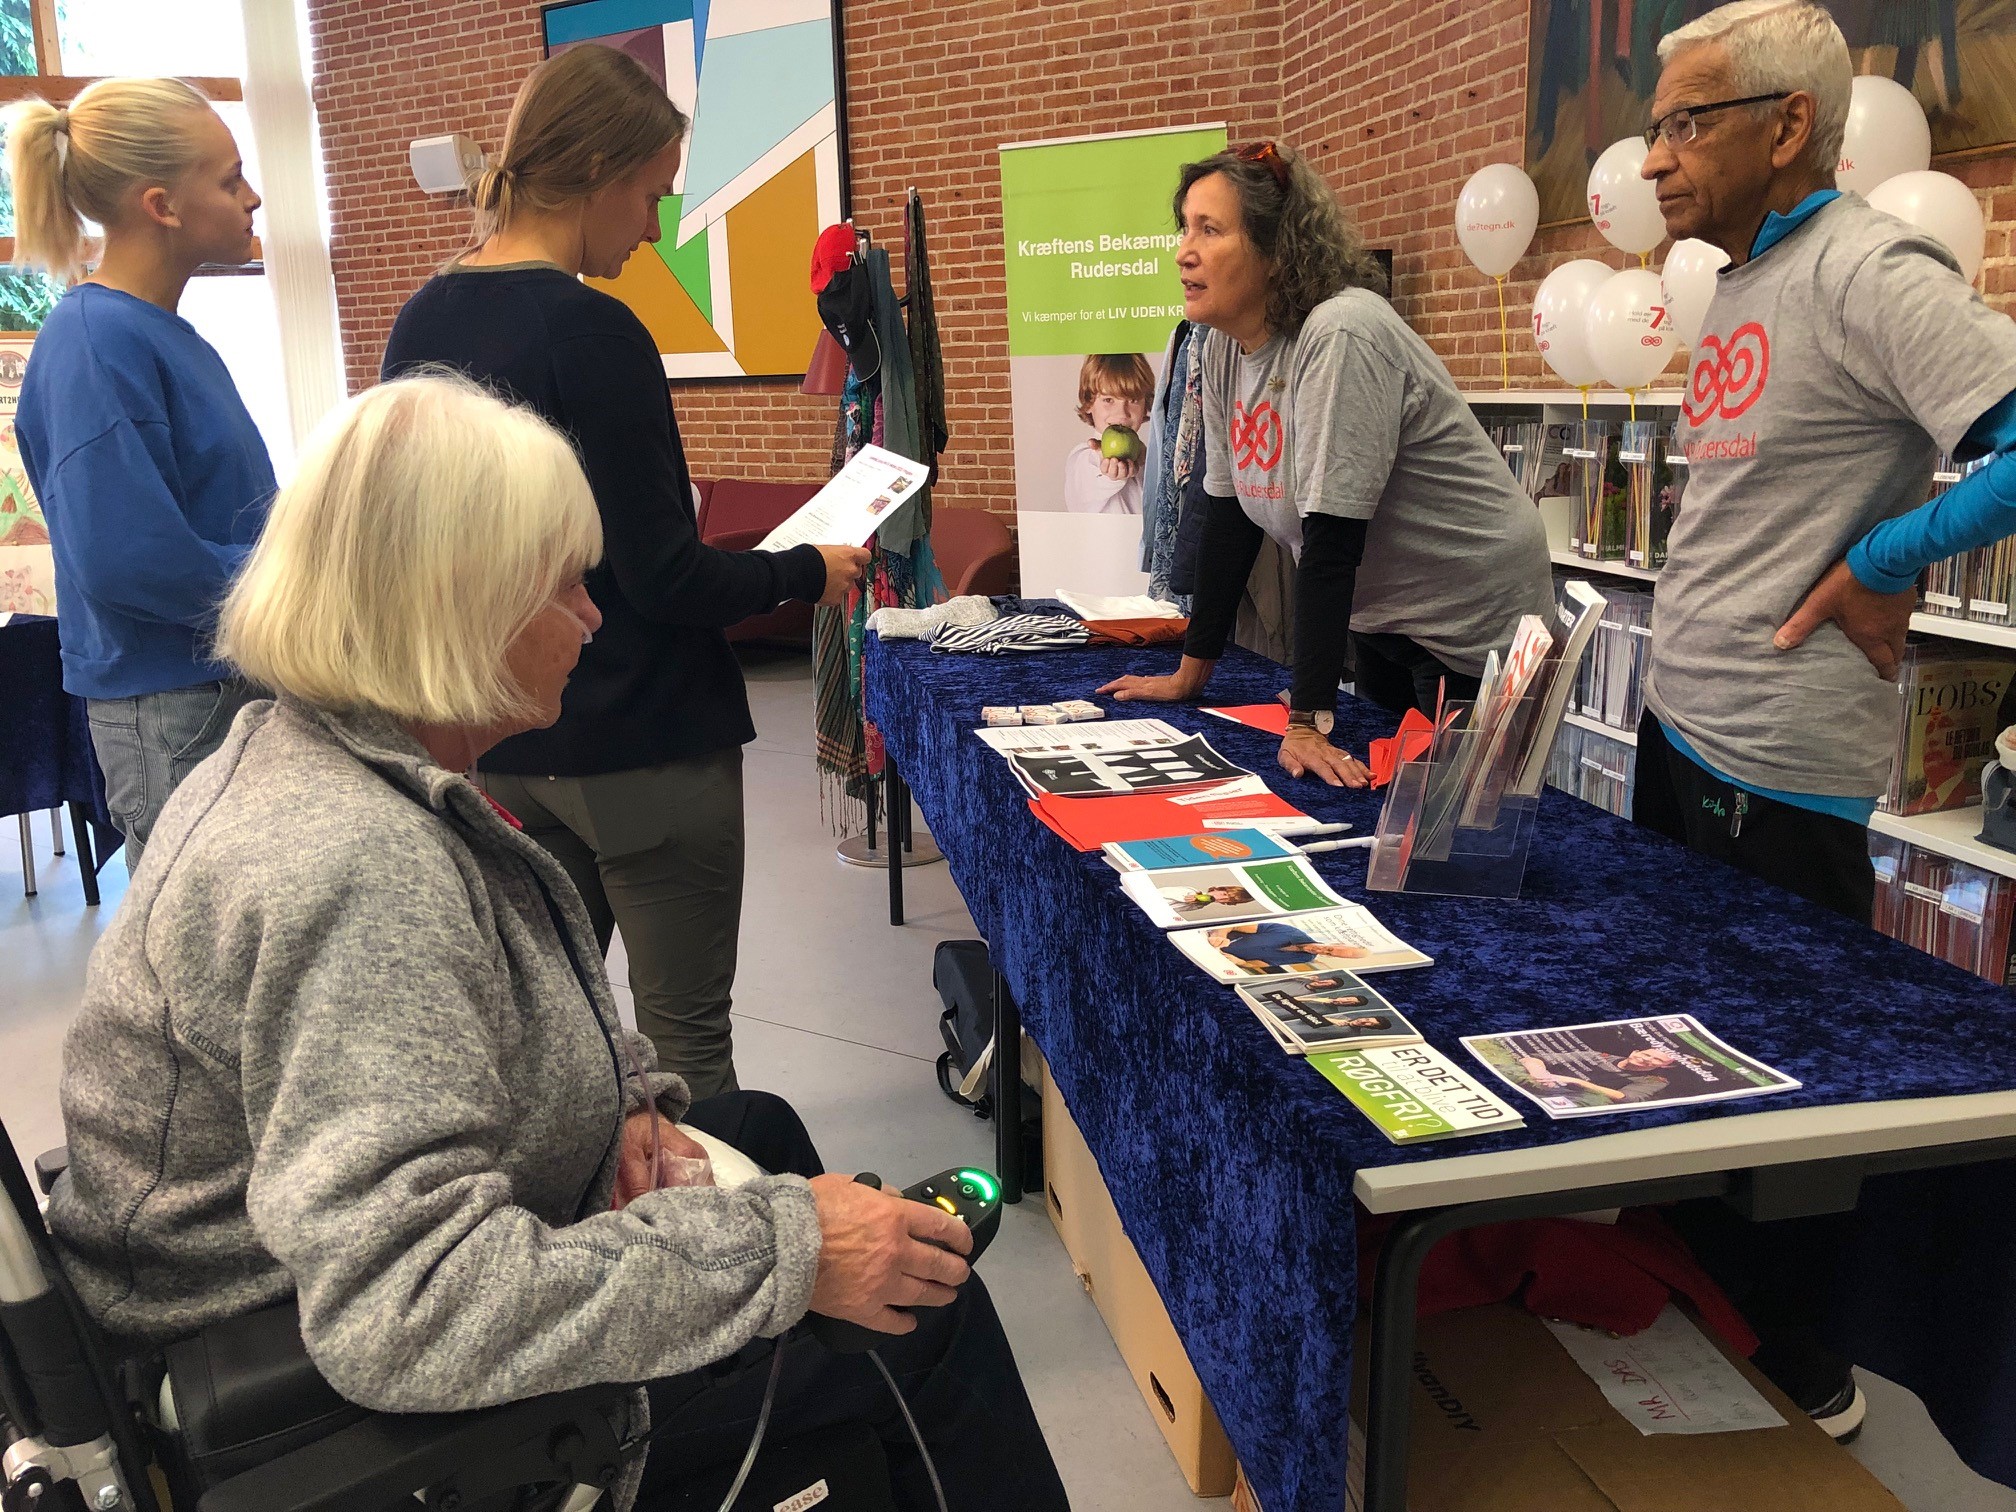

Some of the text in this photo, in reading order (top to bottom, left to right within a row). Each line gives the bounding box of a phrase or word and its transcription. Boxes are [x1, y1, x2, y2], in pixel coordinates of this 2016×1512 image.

[1018, 238, 1094, 257] Kræftens
[1071, 258, 1159, 279] Rudersdal
[1022, 311, 1032, 322] Vi
[1034, 310, 1077, 323] kæmper
[1079, 309, 1094, 320] for
[1096, 310, 1105, 320] et
[1108, 307, 1127, 319] LIV
[1130, 306, 1165, 318] UDEN
[1650, 306, 1666, 330] 7
[1917, 680, 2002, 716] L'OBS
[1329, 1055, 1443, 1129] RØGFRI?
[1382, 1061, 1457, 1114] til at blive
[1391, 1048, 1504, 1120] ER DET TID
